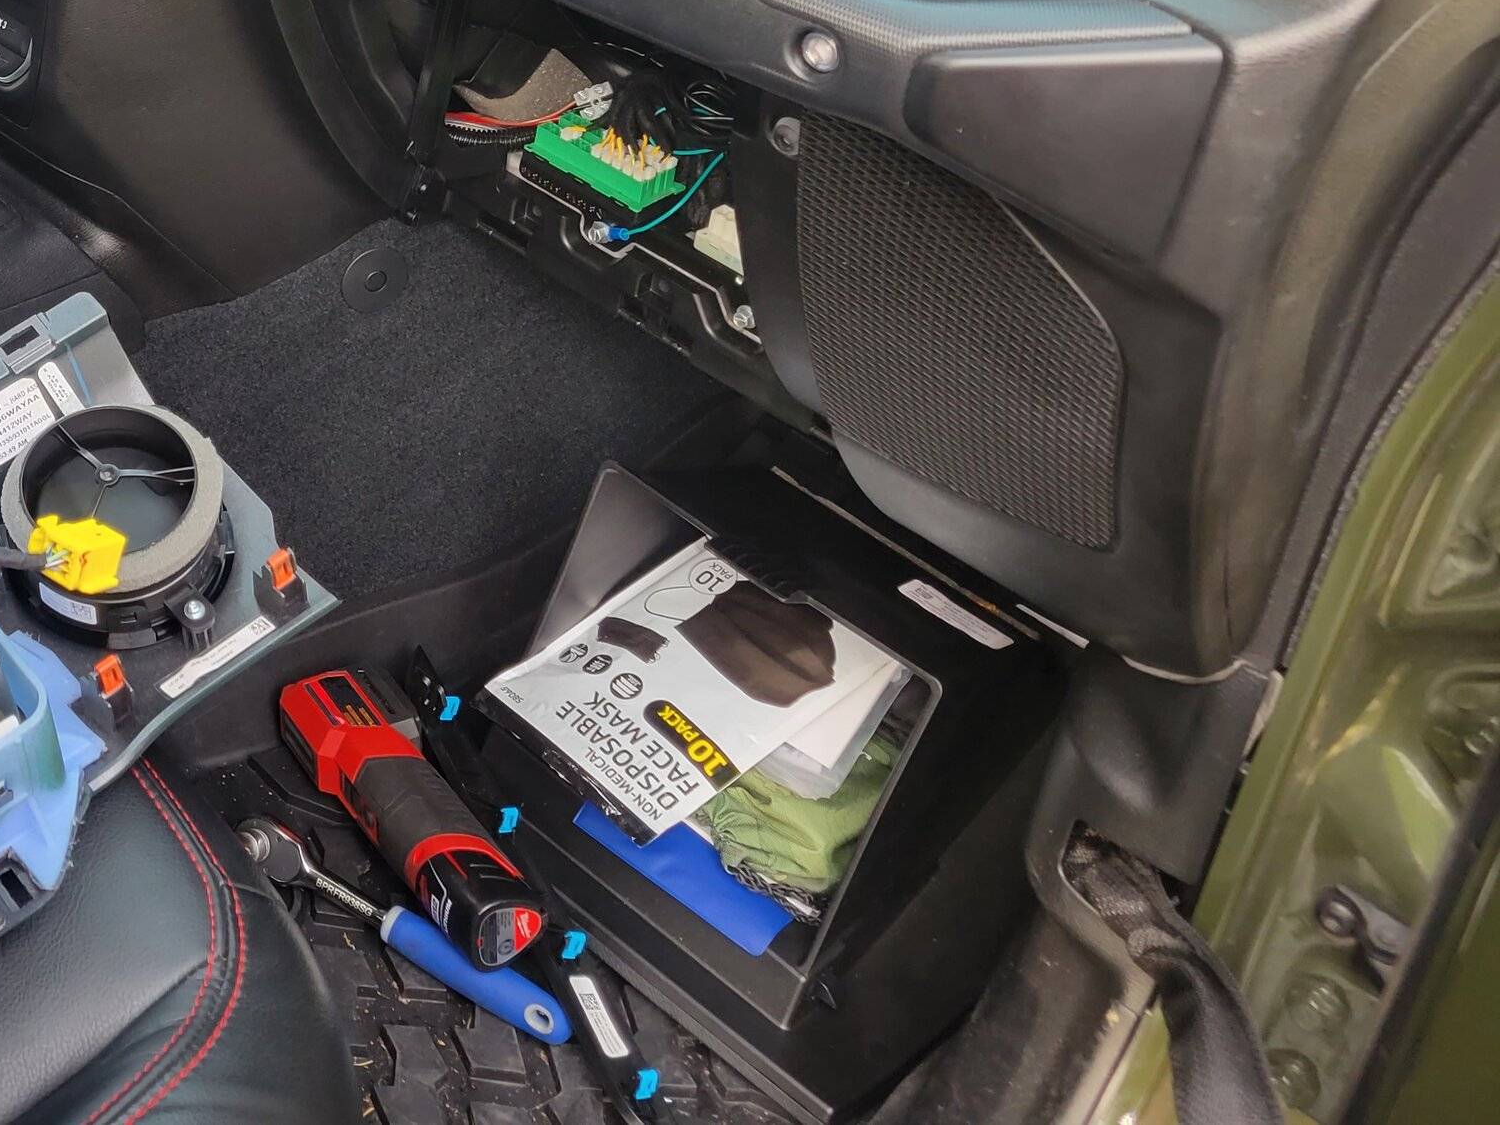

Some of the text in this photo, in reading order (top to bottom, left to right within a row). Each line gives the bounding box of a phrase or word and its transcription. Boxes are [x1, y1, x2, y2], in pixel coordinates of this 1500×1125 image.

[1, 20, 7, 29] 3
[694, 568, 723, 593] 10
[709, 561, 733, 582] PACK
[555, 699, 679, 812] DISPOSABLE
[584, 691, 699, 796] FACE MASK
[657, 704, 729, 778] 10 PACK
[582, 747, 662, 821] NON-MEDICAL
[316, 878, 373, 916] BPRFR938SG
